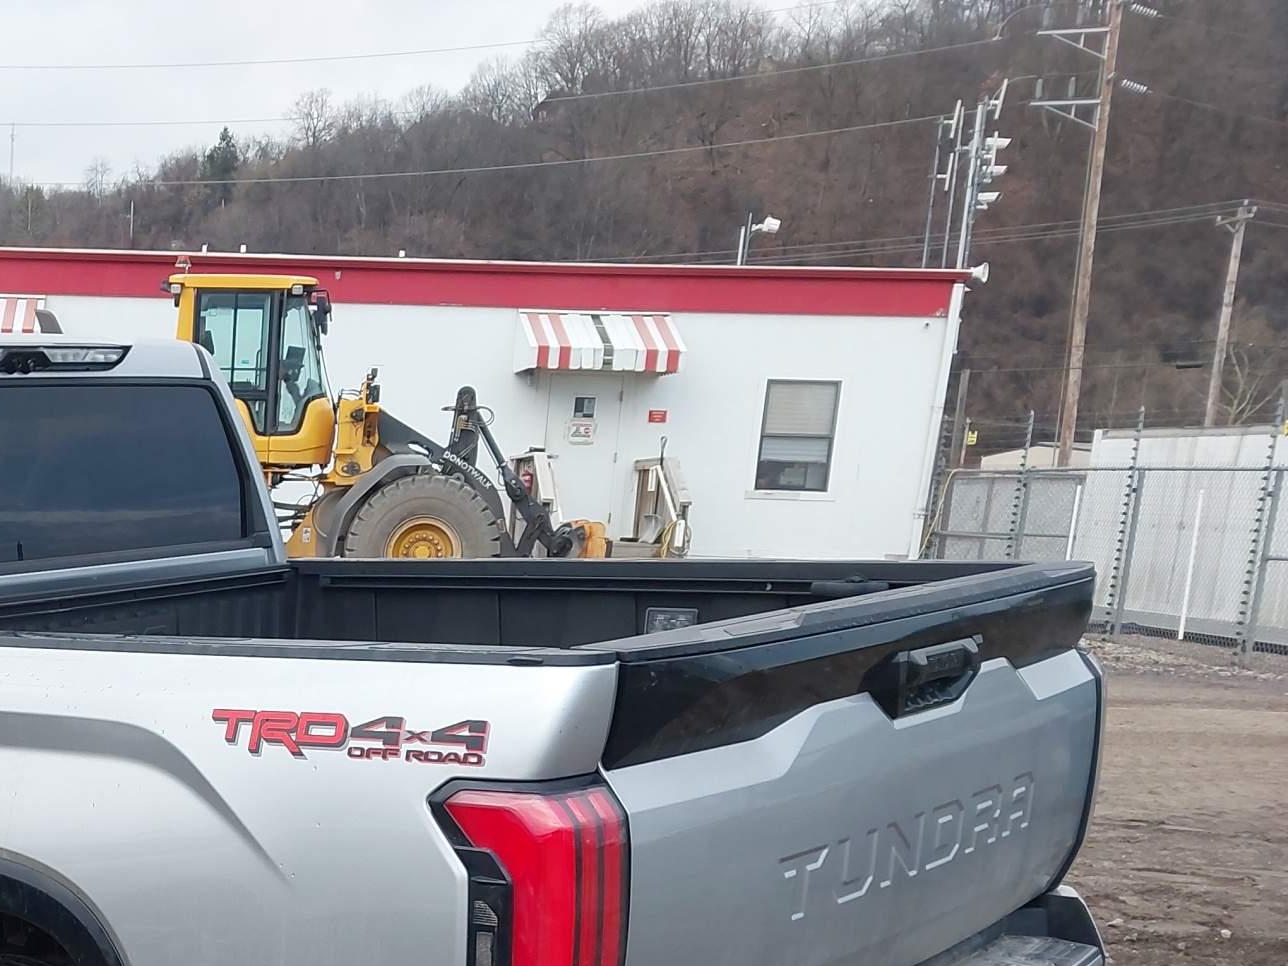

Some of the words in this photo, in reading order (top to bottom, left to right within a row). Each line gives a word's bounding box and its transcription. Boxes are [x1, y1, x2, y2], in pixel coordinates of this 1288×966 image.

[212, 708, 349, 759] TRD
[346, 745, 402, 762] OFF
[404, 748, 485, 768] ROAD
[778, 770, 1035, 921] TUNDRA
